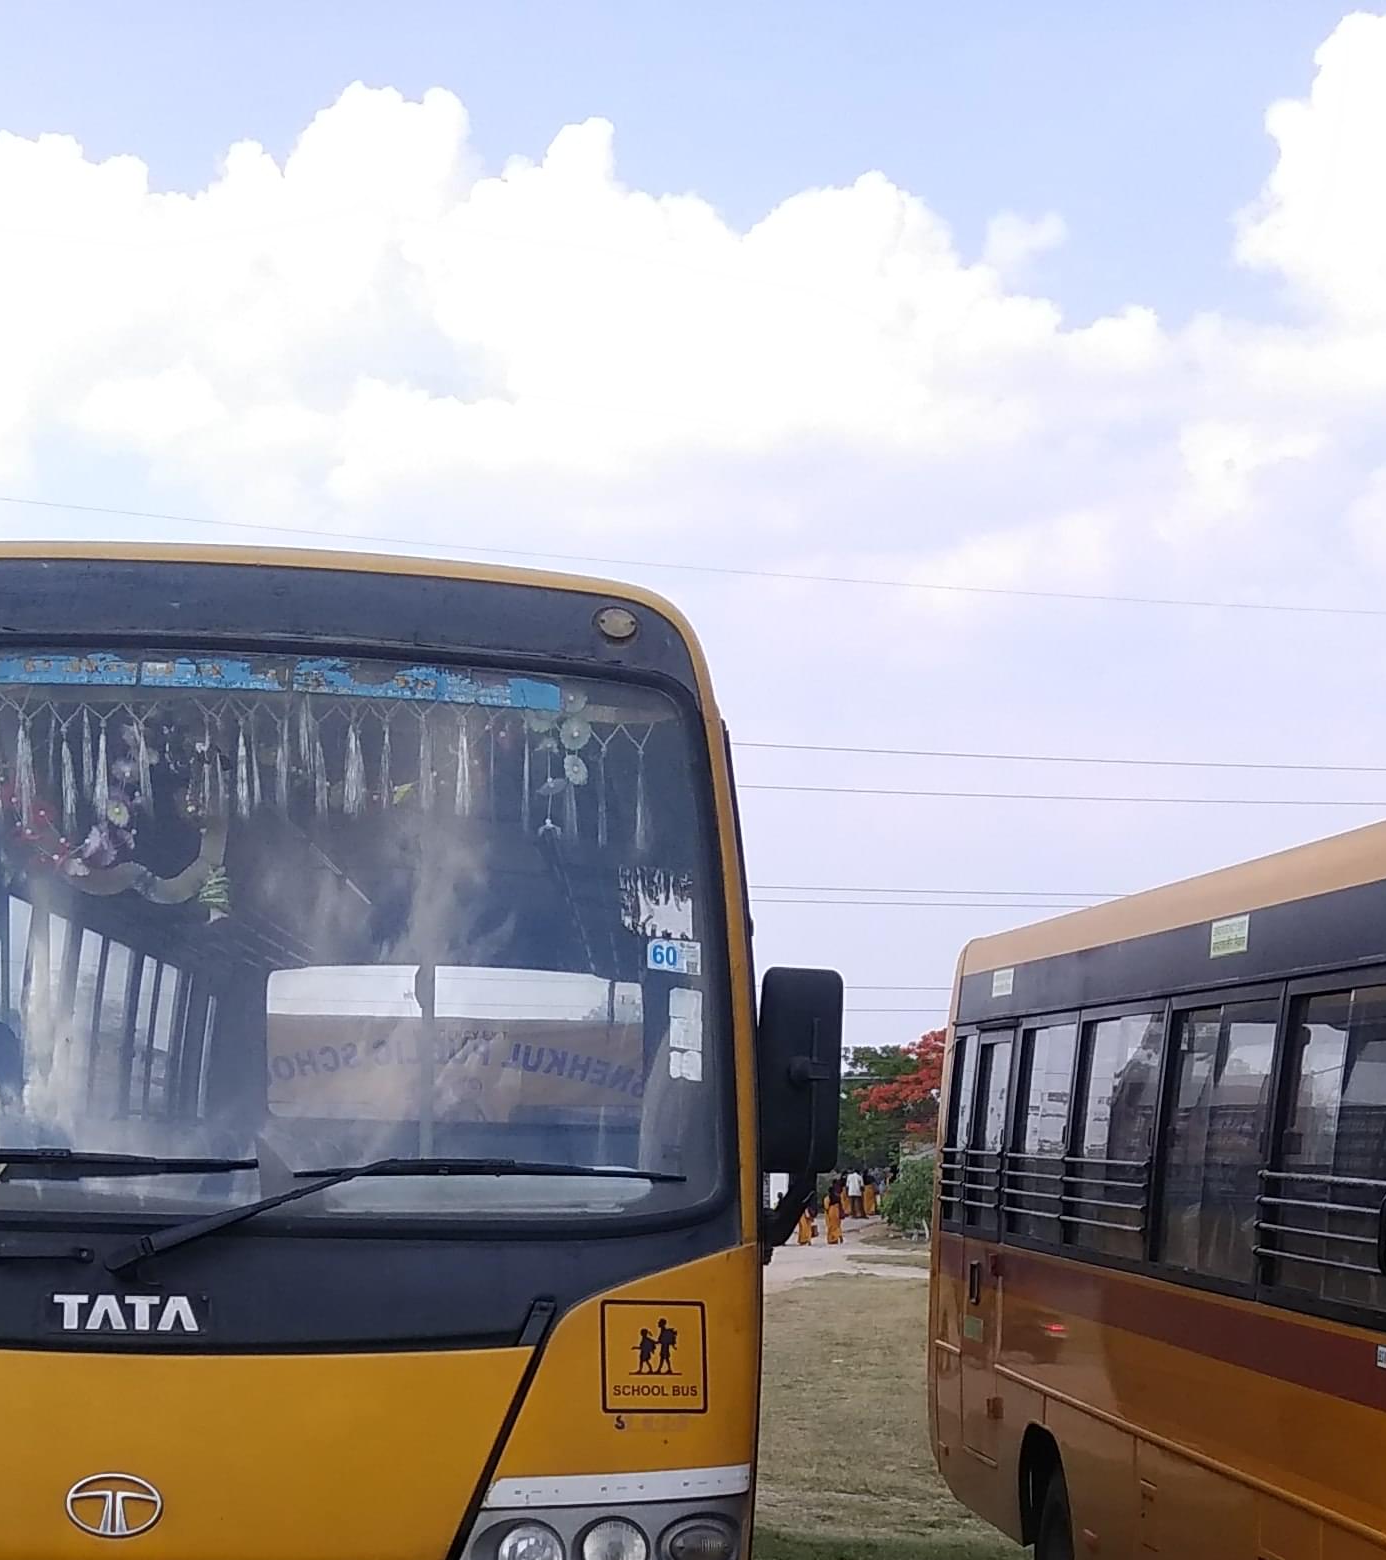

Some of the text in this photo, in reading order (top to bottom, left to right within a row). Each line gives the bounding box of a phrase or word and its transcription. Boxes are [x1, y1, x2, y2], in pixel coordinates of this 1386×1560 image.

[653, 944, 677, 966] 60
[53, 1294, 199, 1331] TATA
[613, 1385, 698, 1397] SCHOOL BUS
